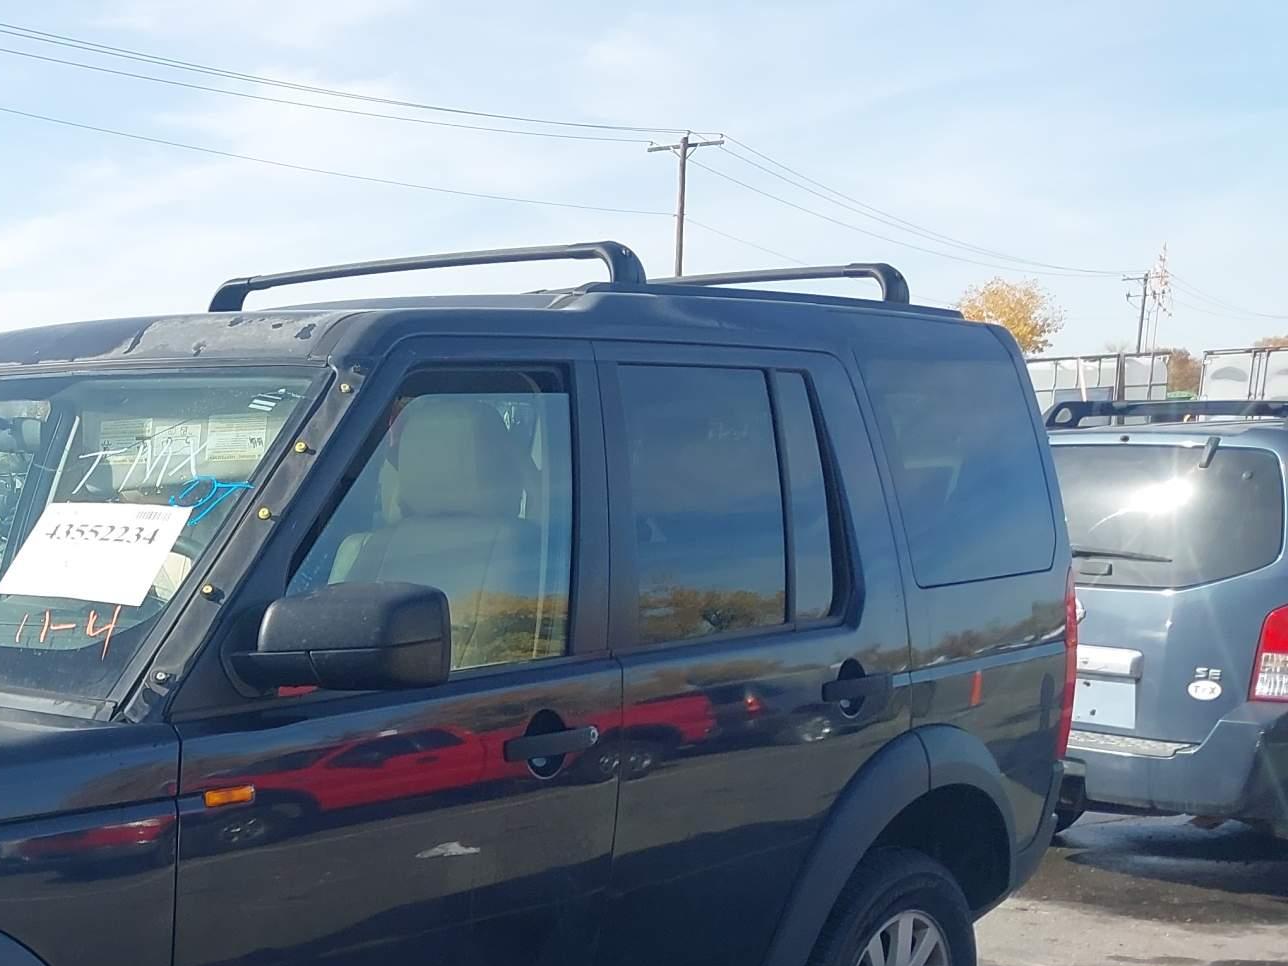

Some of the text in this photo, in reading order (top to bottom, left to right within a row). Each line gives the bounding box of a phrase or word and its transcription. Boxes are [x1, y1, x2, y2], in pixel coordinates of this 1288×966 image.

[45, 523, 160, 544] 43552234
[15, 604, 121, 661] 11-4
[1194, 667, 1222, 680] SE
